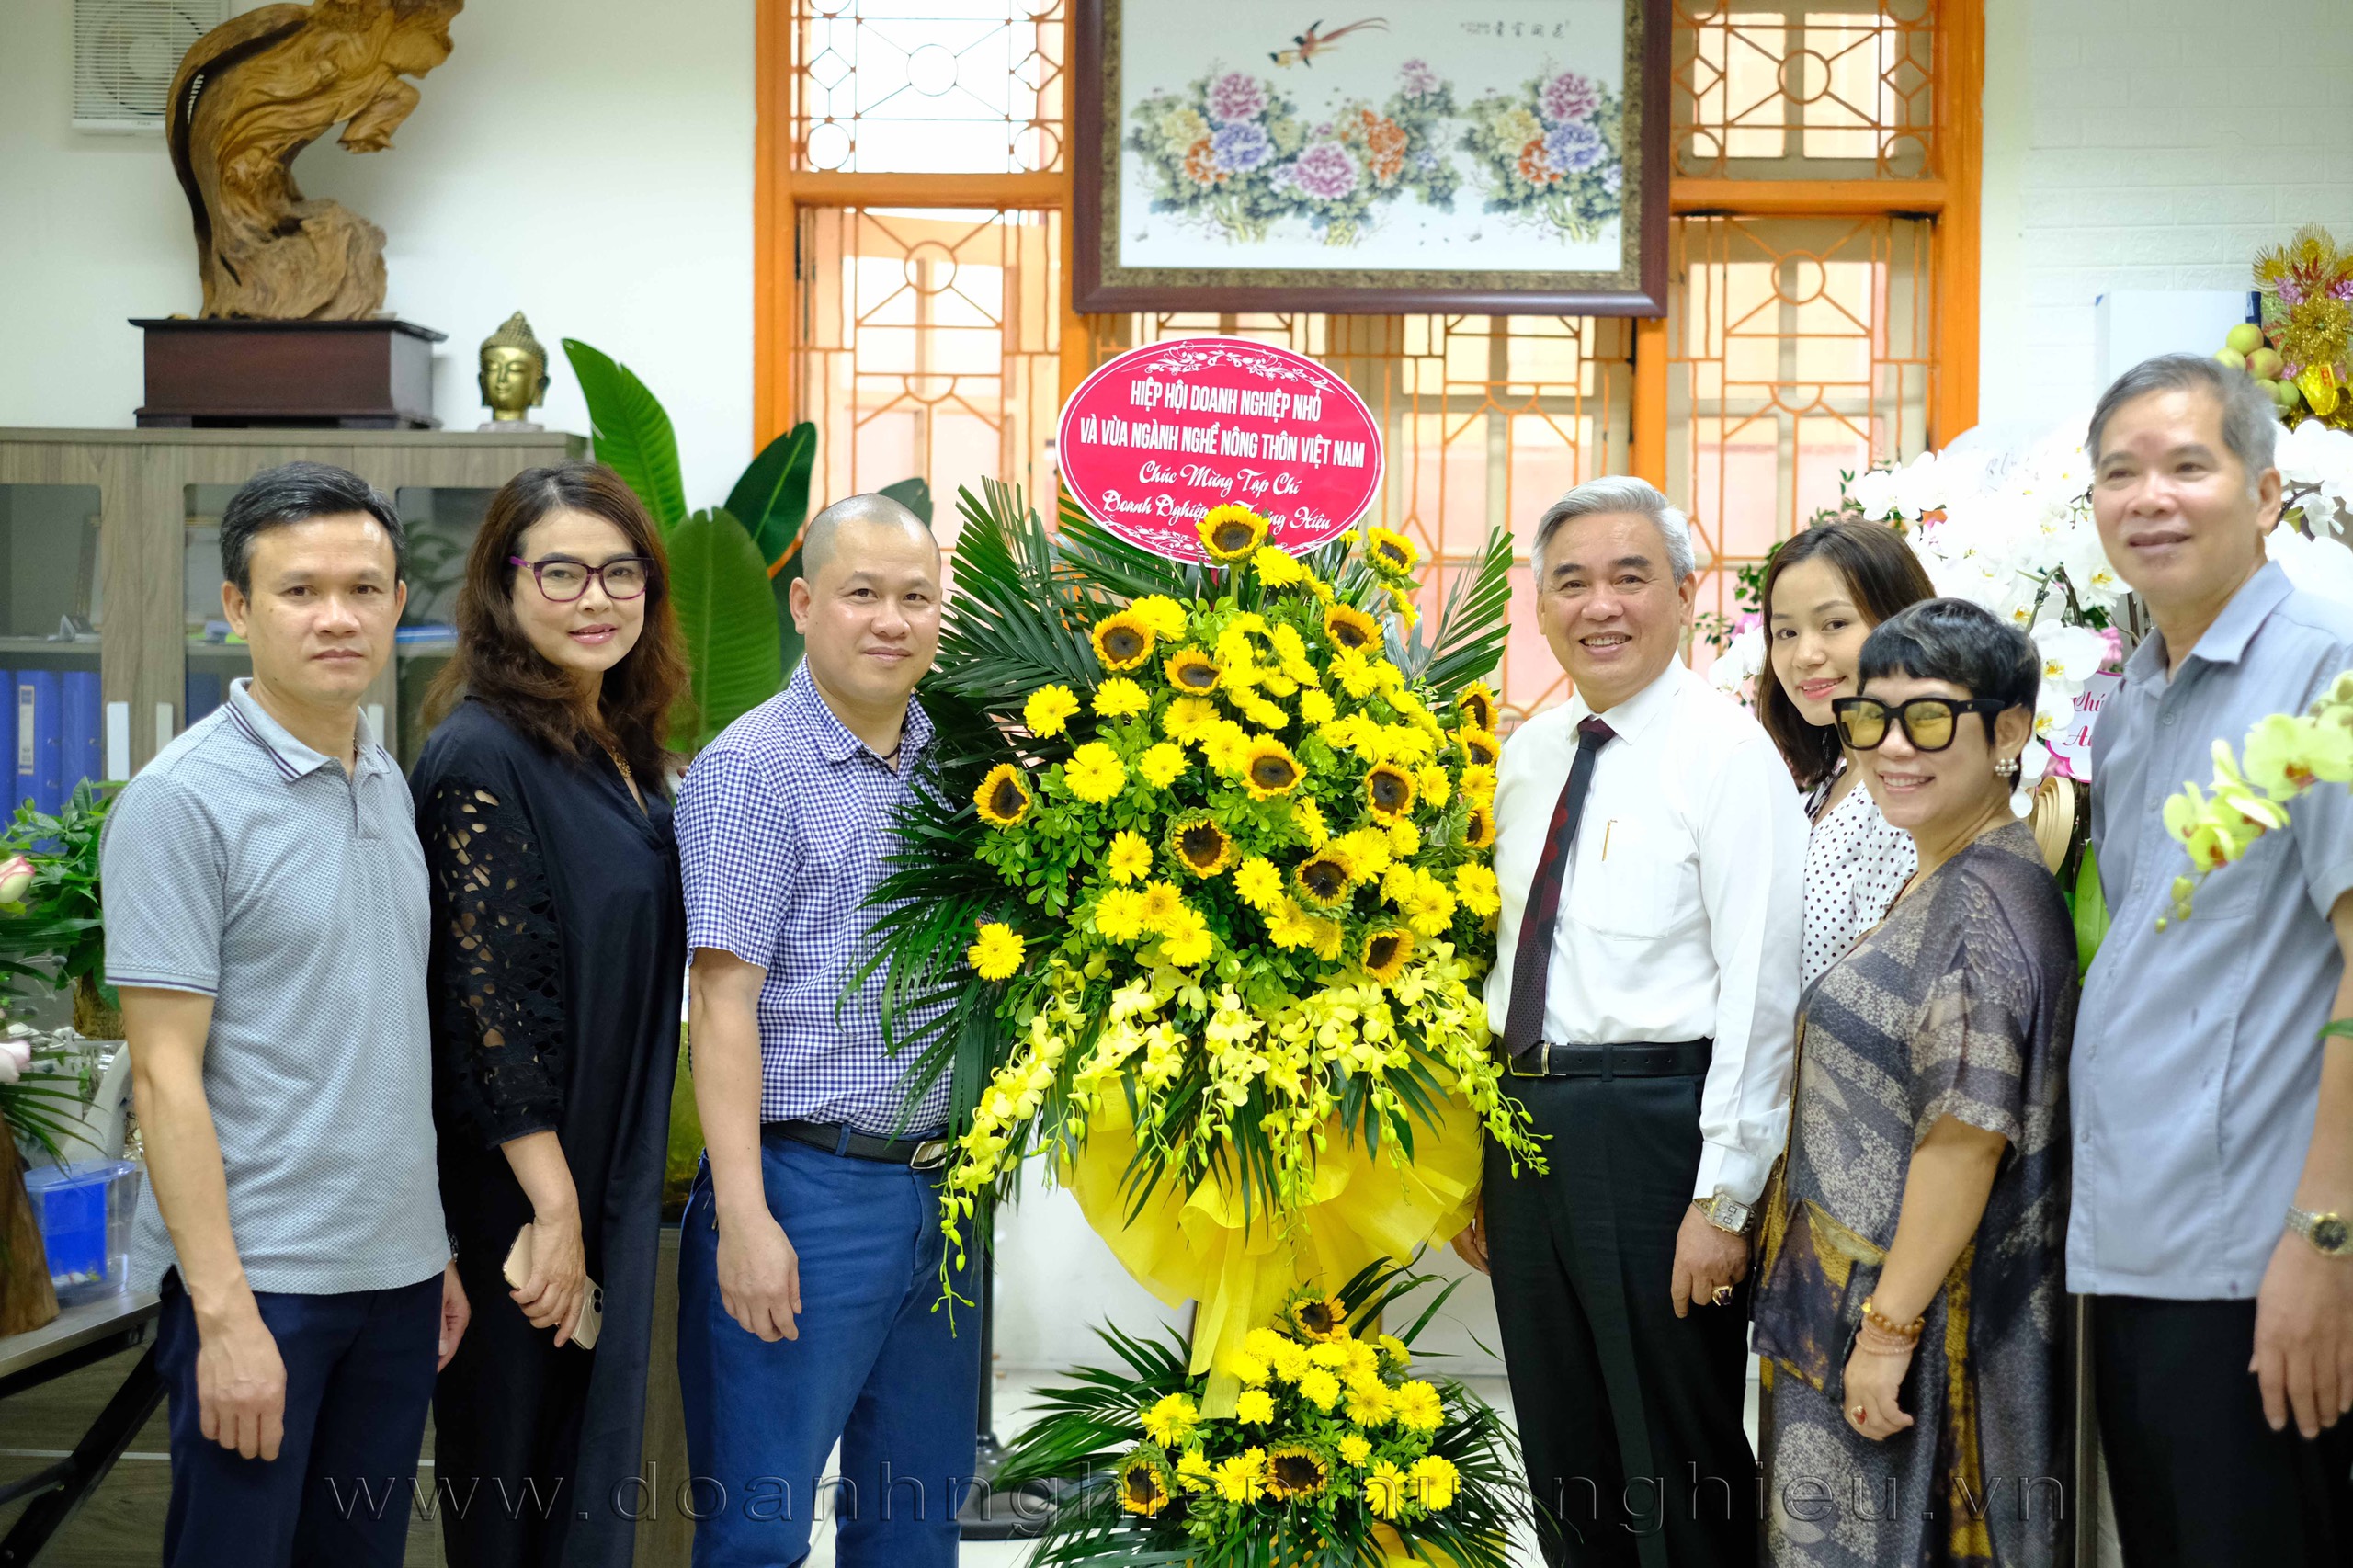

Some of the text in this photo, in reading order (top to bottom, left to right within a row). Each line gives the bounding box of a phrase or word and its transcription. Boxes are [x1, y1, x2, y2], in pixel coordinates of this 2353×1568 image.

[1130, 376, 1322, 423] HIỆP HỘI DOANH NGHIỆP NHỎ
[1080, 414, 1366, 469] VÀ VỪA NGÀNH NGHỀ NÔNG THÔN VIỆT NAM
[1139, 460, 1302, 499] Chúc Mừng Tạp Chí
[1101, 489, 1153, 515] Doanh
[1289, 506, 1332, 532] Hiệu
